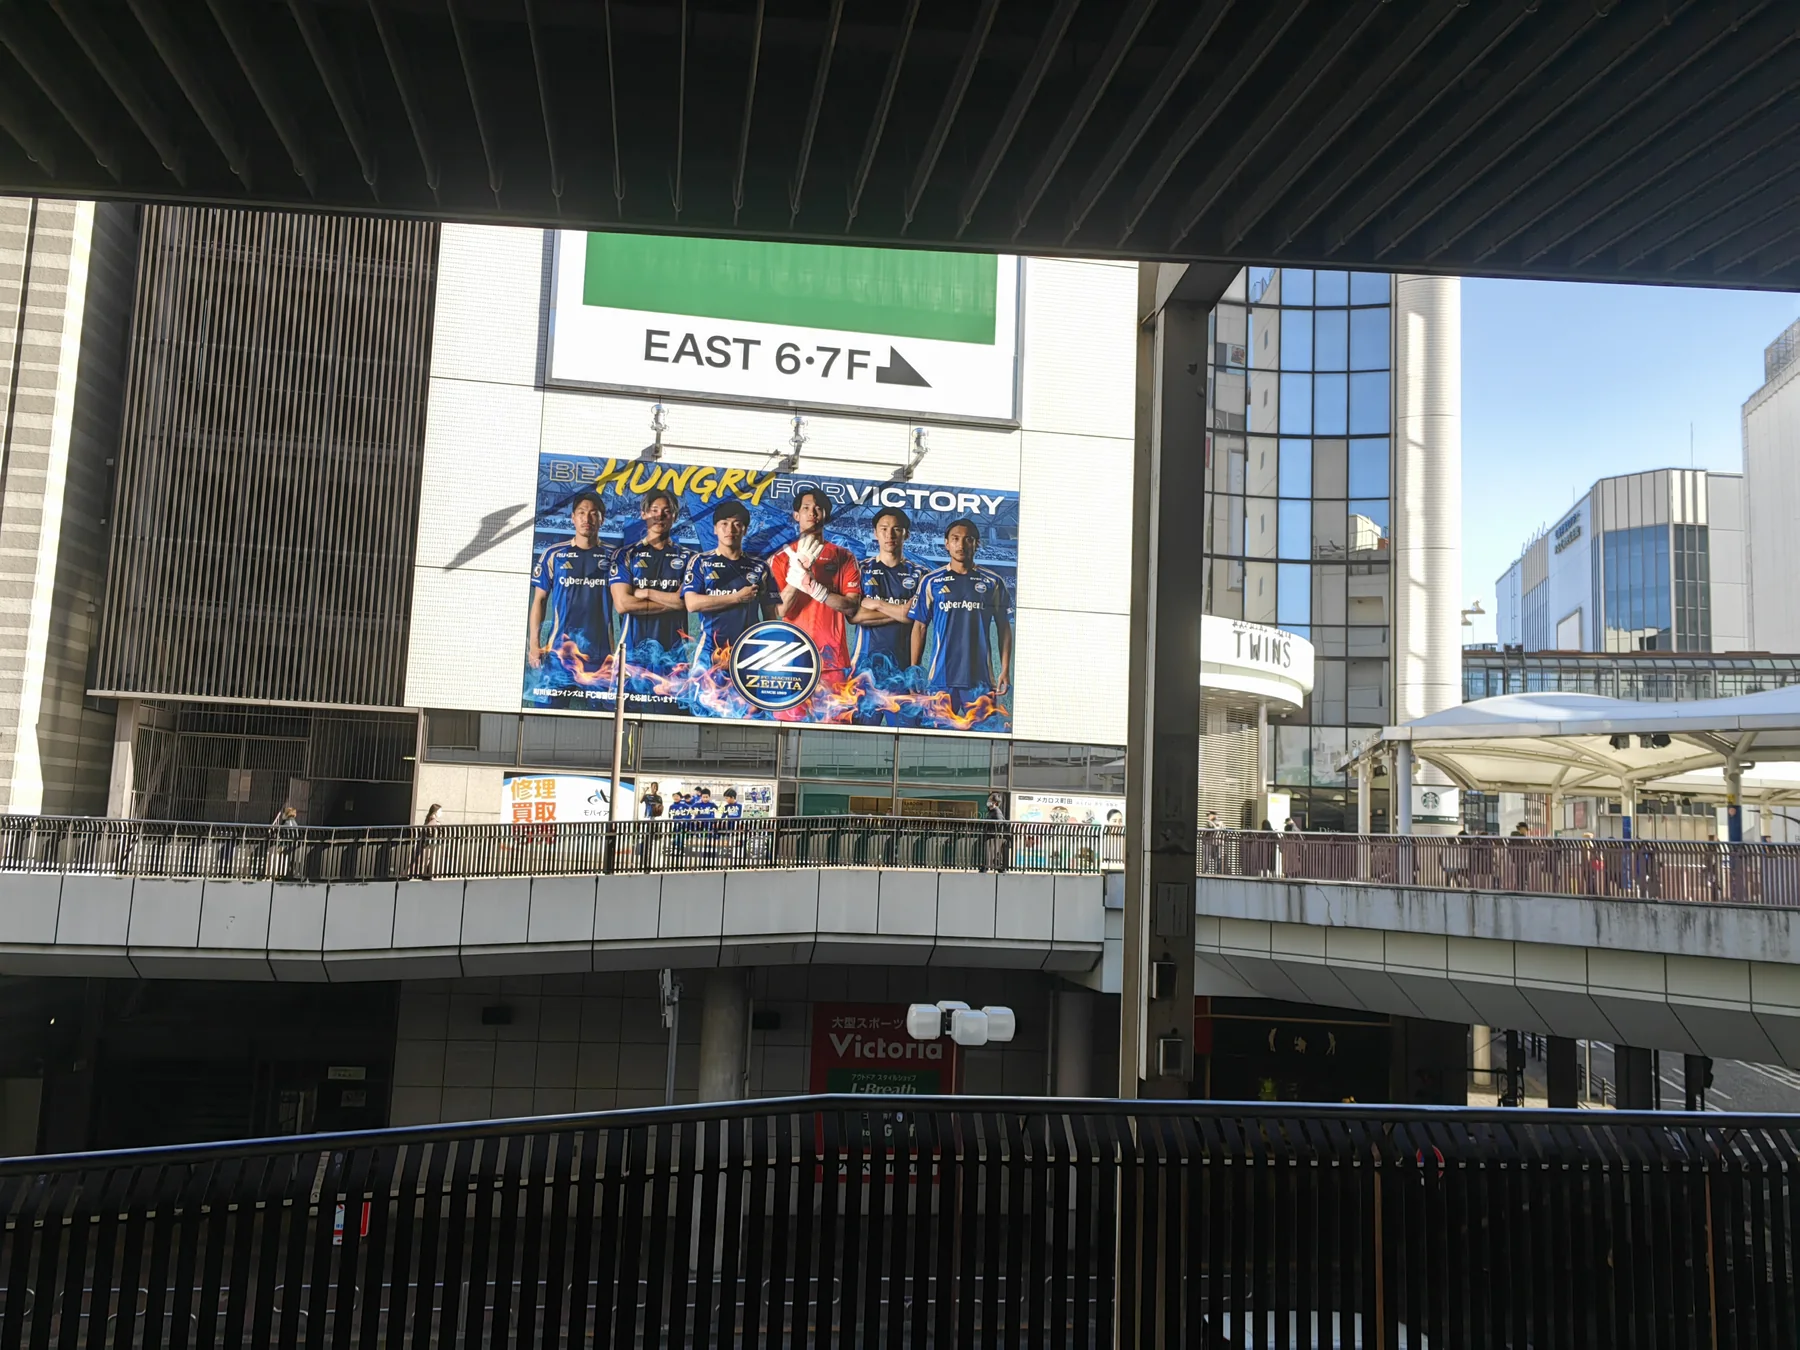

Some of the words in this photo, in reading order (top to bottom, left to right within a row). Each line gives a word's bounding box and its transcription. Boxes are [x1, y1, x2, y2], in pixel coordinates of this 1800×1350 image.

[643, 328, 761, 370] EAST
[550, 460, 600, 484] BE
[595, 458, 776, 506] HUNGRY
[846, 484, 1005, 515] VICTORY
[559, 576, 605, 588] CyberAgen
[1232, 630, 1291, 668] TWINS
[745, 674, 803, 691] ZELVIA
[511, 778, 556, 800] 修理
[512, 802, 557, 823] 買取
[829, 1033, 943, 1060] Victoria
